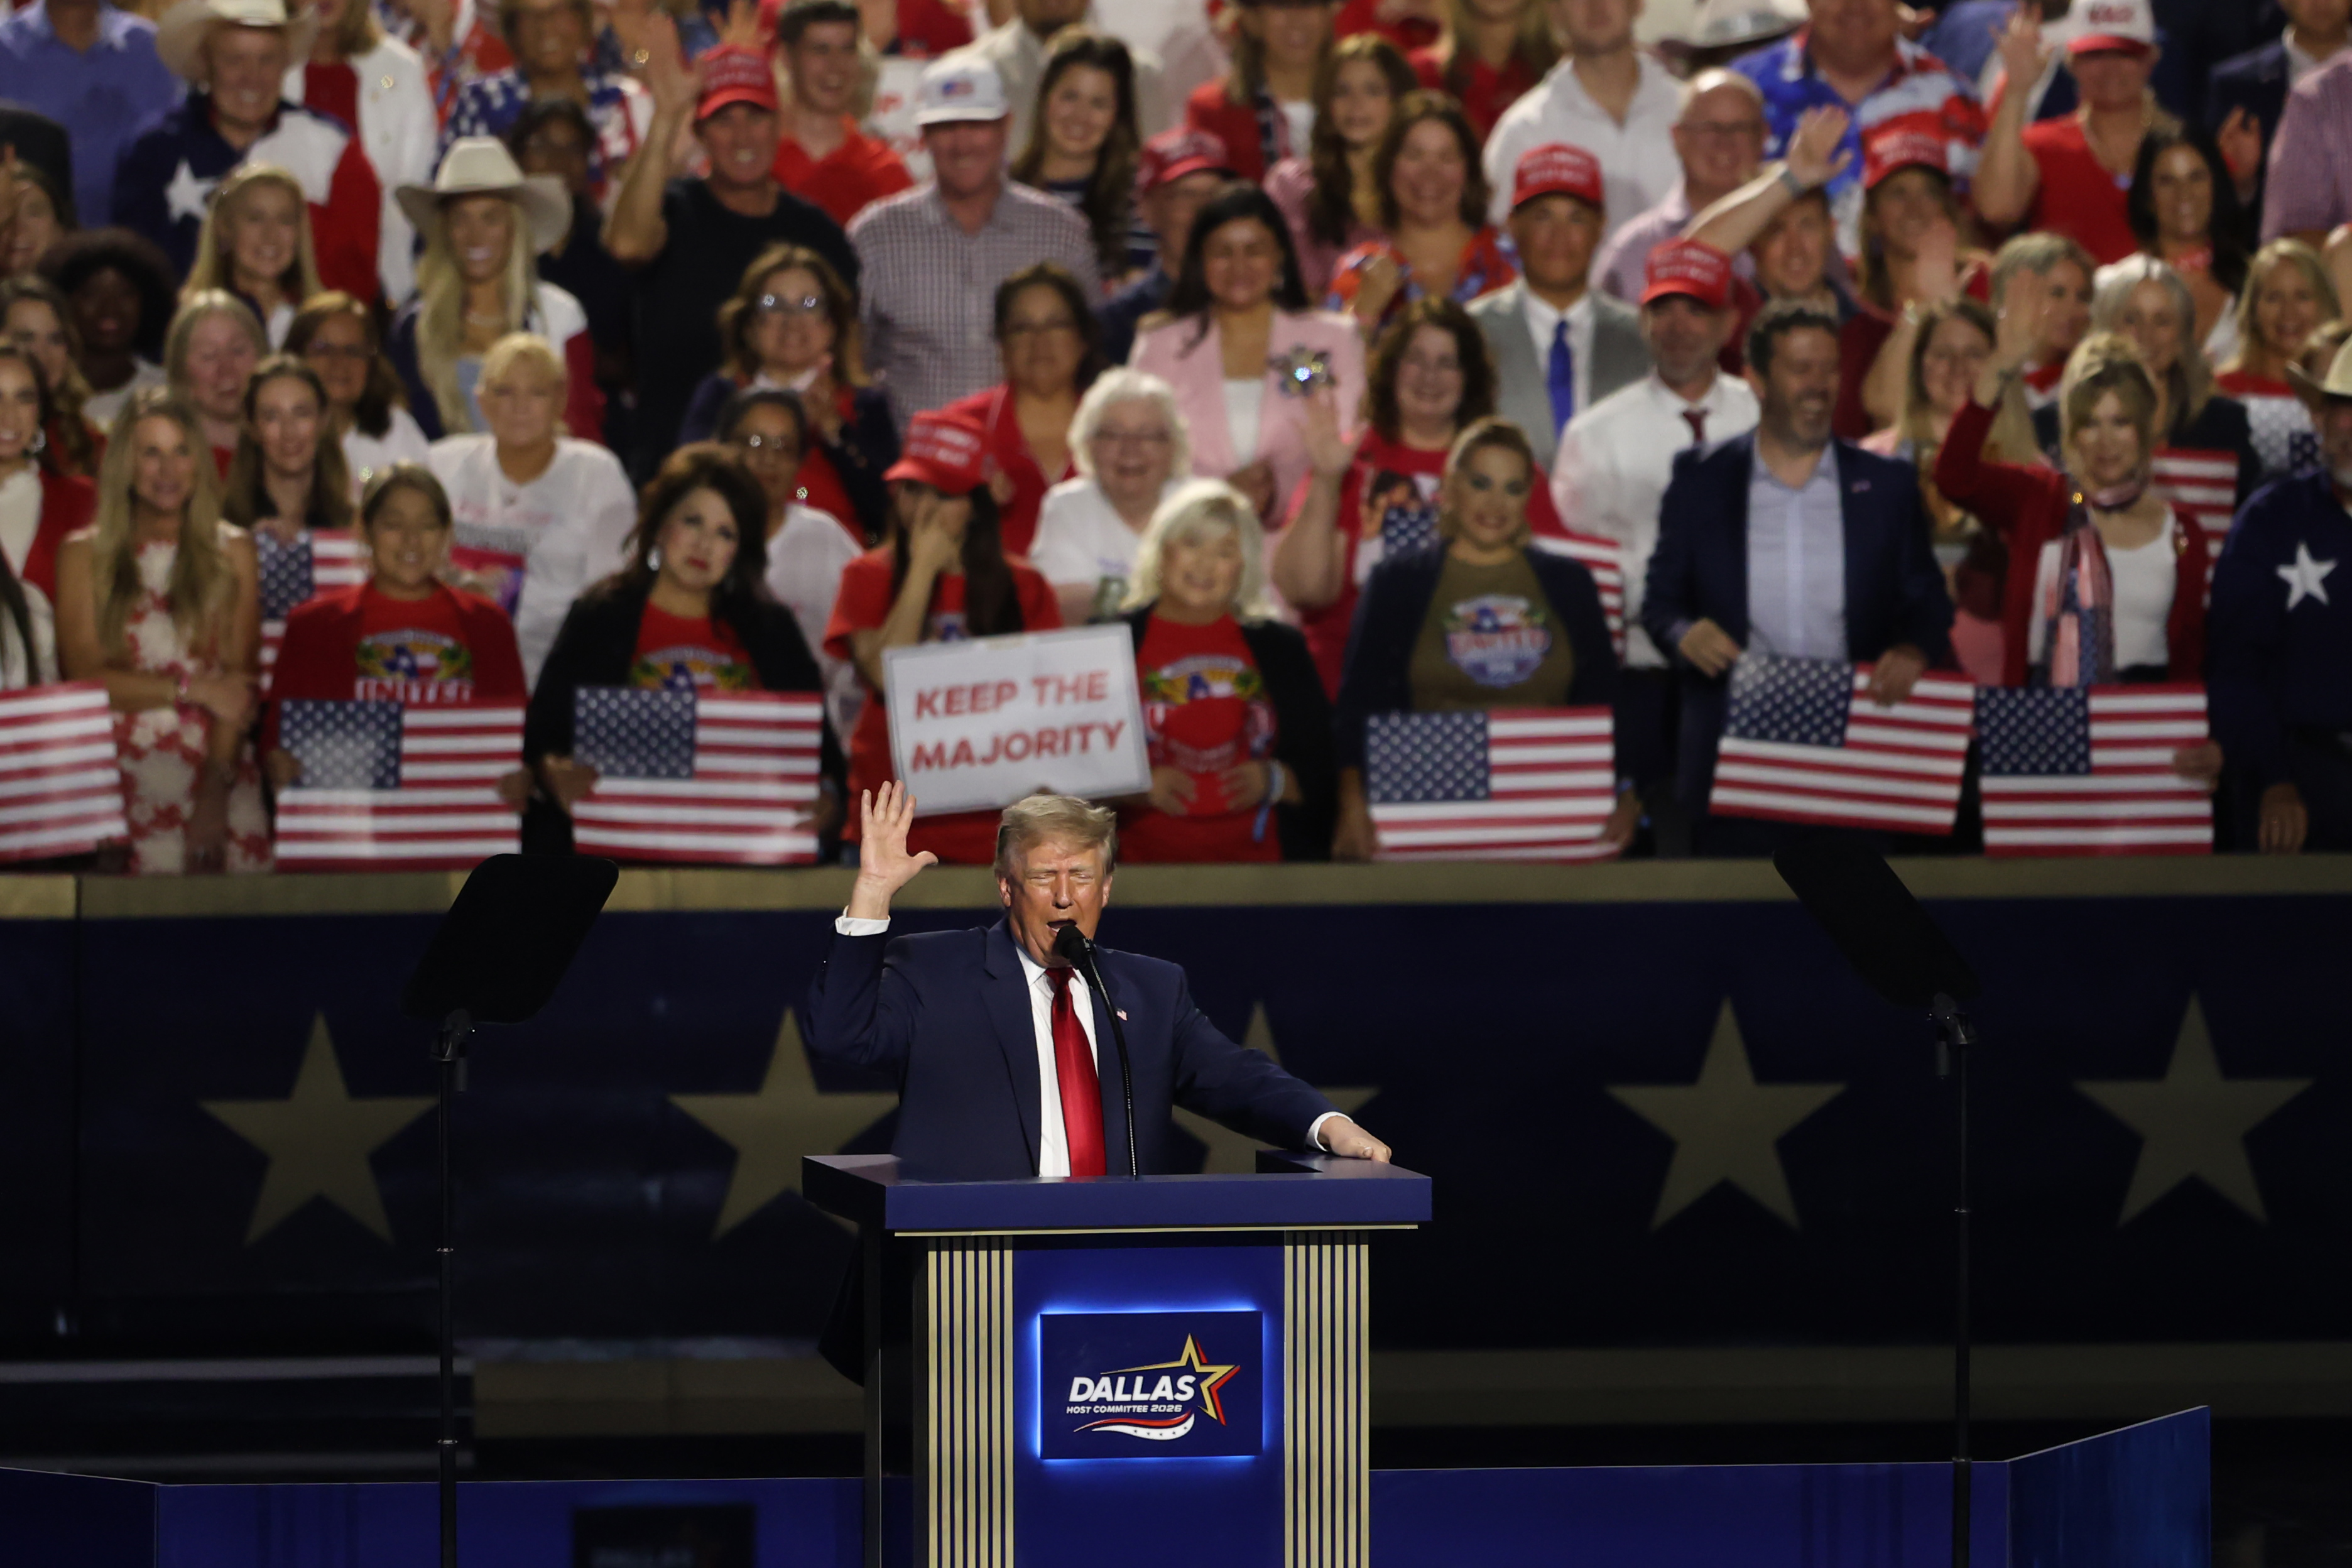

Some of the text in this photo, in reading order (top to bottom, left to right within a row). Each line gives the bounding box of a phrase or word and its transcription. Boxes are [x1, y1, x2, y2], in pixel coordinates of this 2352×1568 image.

[914, 670, 1109, 720] KEEP THE
[911, 719, 1125, 773] MAJORITY
[1069, 1375, 1196, 1402] DALLAS
[1066, 1404, 1183, 1414] HOST COMMITTEE 2026
